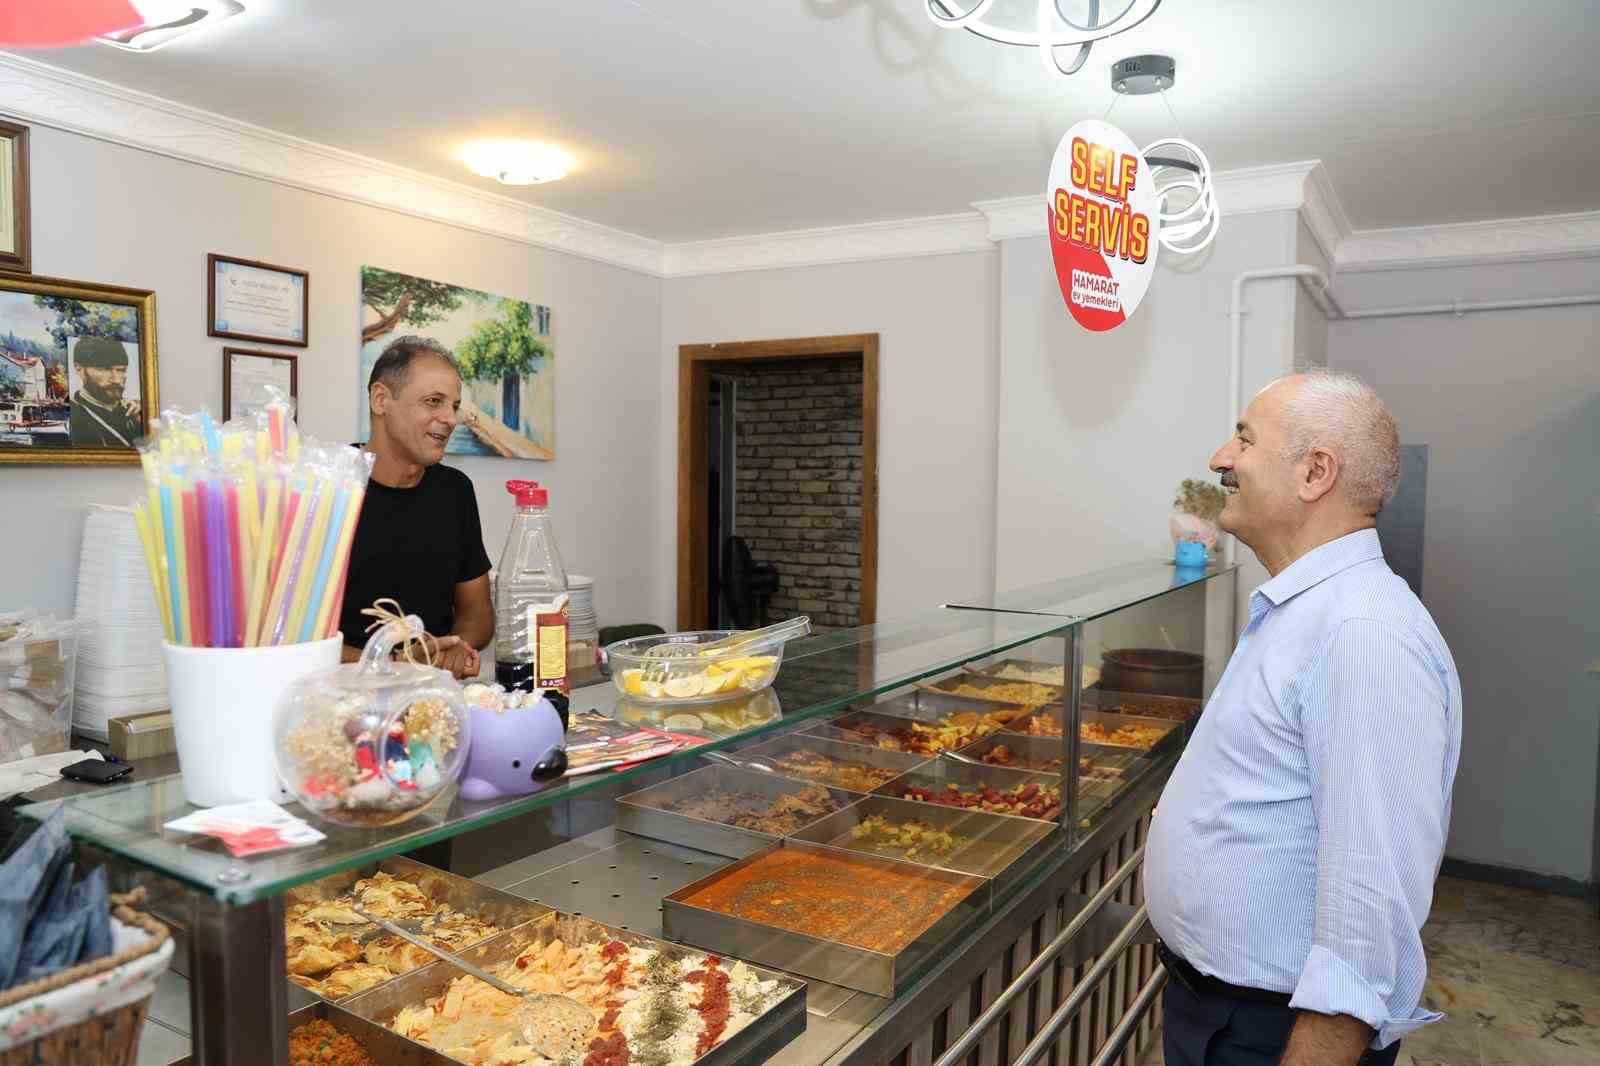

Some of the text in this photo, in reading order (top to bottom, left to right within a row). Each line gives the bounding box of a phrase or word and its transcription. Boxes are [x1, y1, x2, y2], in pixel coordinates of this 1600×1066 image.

[1071, 137, 1138, 202] SELF
[1054, 188, 1149, 264] SERVİS
[1073, 273, 1119, 296] HAMARAT
[1081, 294, 1119, 308] yemekleri
